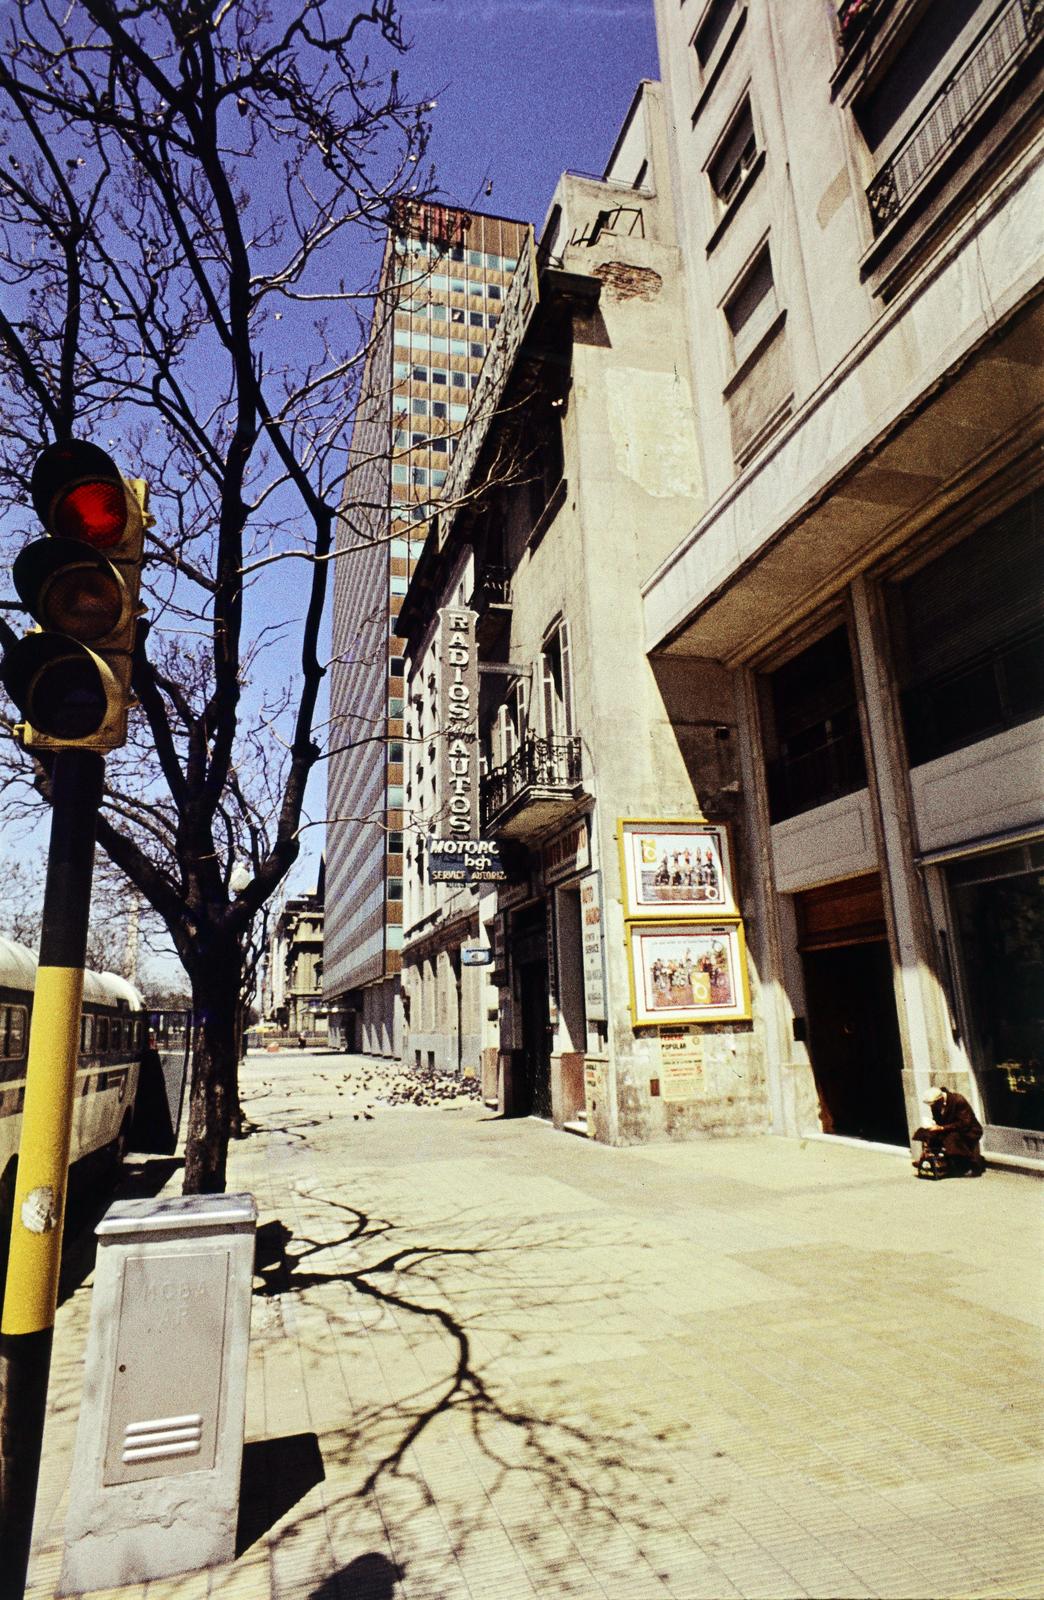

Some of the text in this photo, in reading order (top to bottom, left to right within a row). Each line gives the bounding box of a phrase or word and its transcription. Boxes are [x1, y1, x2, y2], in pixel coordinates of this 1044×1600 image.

[448, 614, 470, 720] RADIOS
[448, 739, 471, 833] AUTOS
[432, 870, 466, 880] SERVICE
[464, 853, 492, 871] bgh
